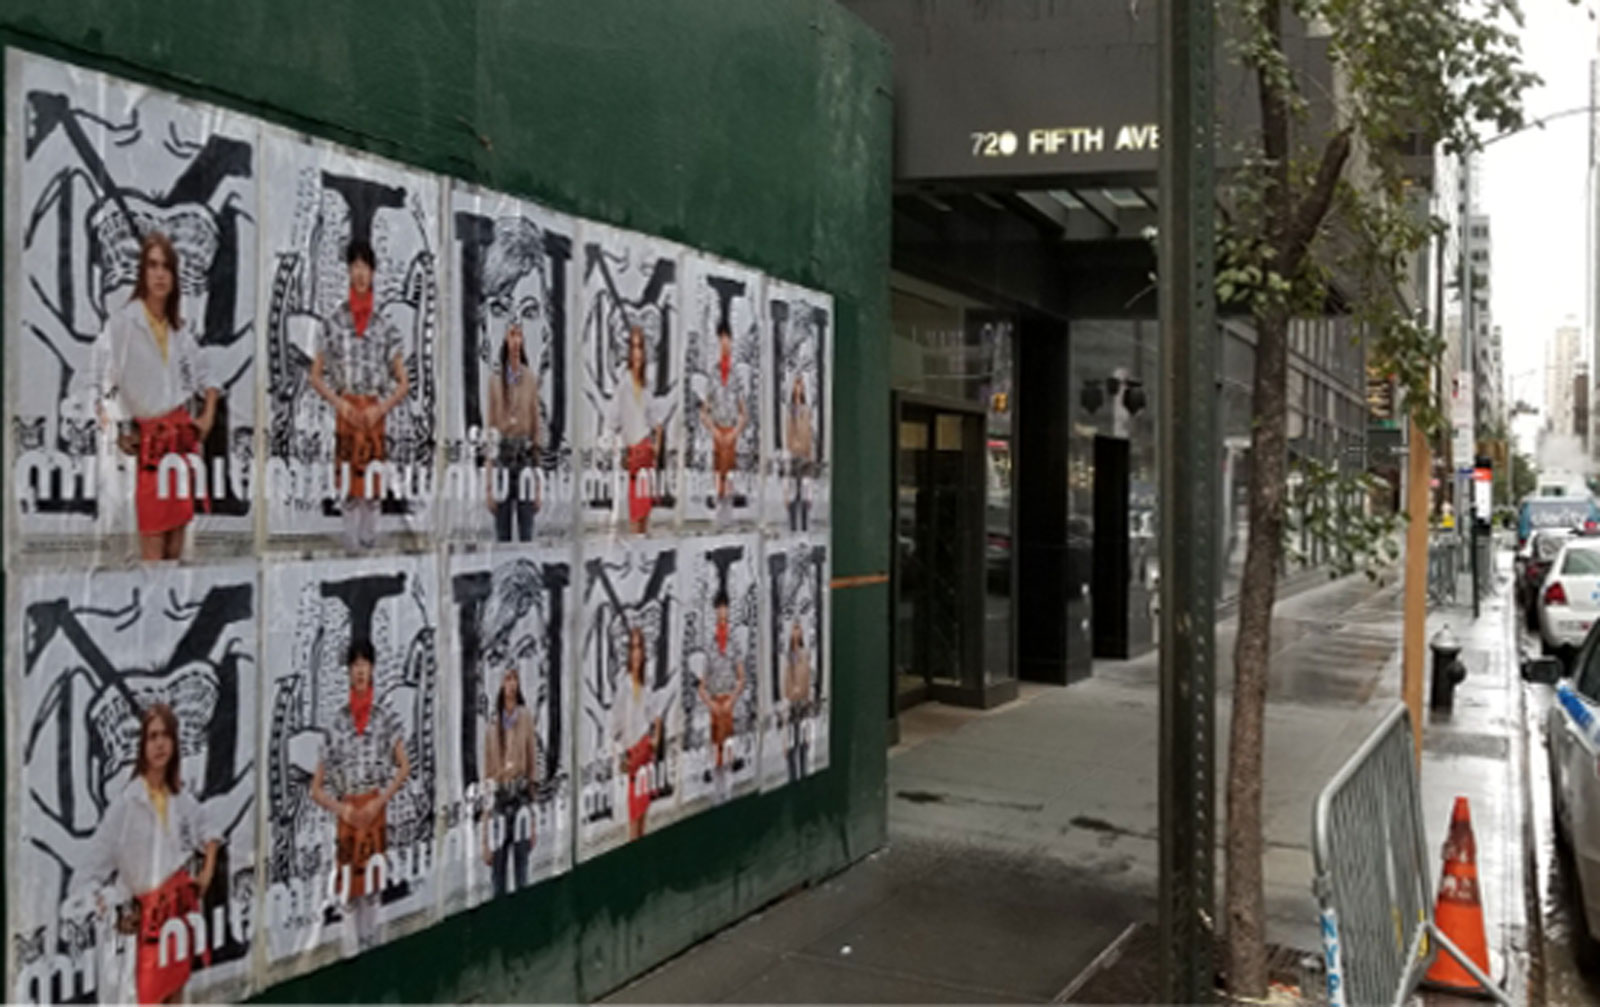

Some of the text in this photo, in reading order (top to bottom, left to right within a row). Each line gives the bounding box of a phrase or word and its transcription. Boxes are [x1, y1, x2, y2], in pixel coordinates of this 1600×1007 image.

[970, 124, 1160, 156] 720 FIFTH AVE
[1320, 914, 1343, 1007] NYP
